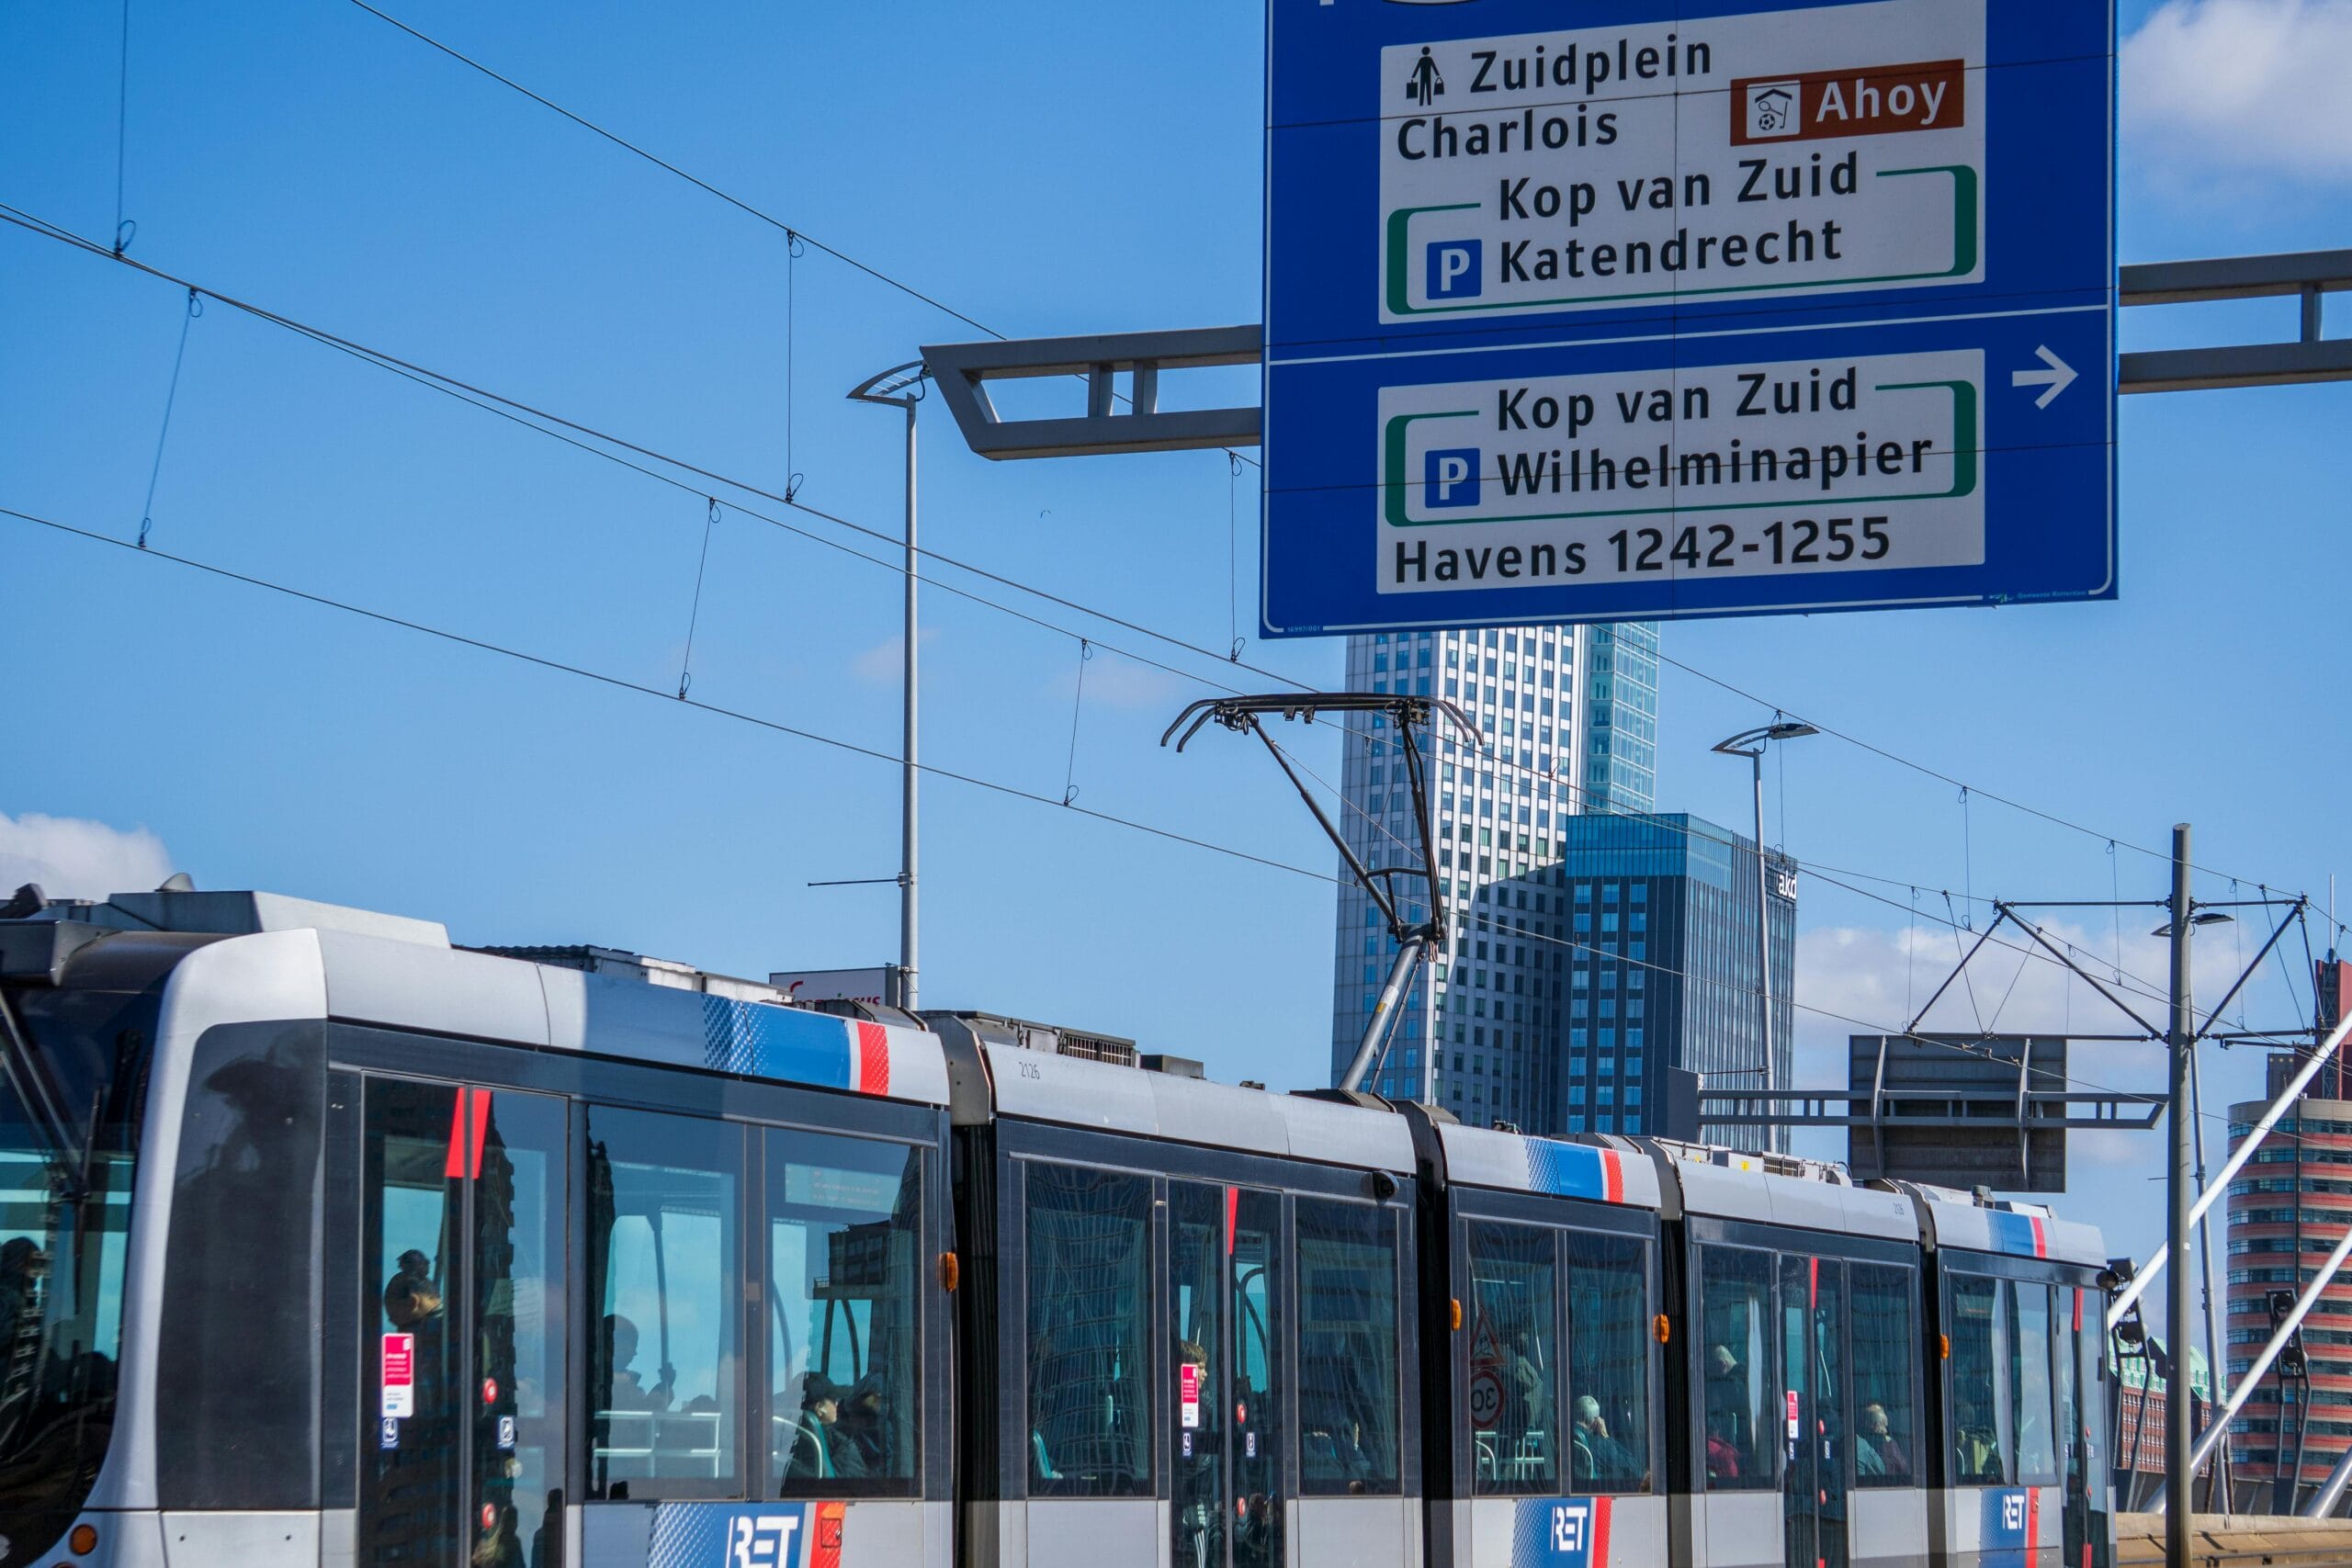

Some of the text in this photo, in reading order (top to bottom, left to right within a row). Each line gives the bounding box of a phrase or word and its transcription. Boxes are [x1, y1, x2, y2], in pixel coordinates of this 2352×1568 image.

[1470, 34, 1711, 96] Zuidplein
[1815, 78, 1947, 125] Ahoy
[1397, 104, 1618, 161] Charlois
[1499, 150, 1857, 228] Kop van Zuid
[1441, 248, 1470, 292] P
[1500, 219, 1842, 284] Katendrecht
[1498, 366, 1856, 439] Kop van Zuid
[1439, 457, 1469, 501] P
[1498, 432, 1933, 496] Wilhelminapier
[1396, 515, 1890, 583] Havens 1242-1255
[1779, 870, 1797, 899] akd
[1019, 1061, 1040, 1079] 2126
[1551, 1506, 1588, 1551] RET
[2003, 1495, 2024, 1529] RET
[725, 1516, 799, 1568] RET
